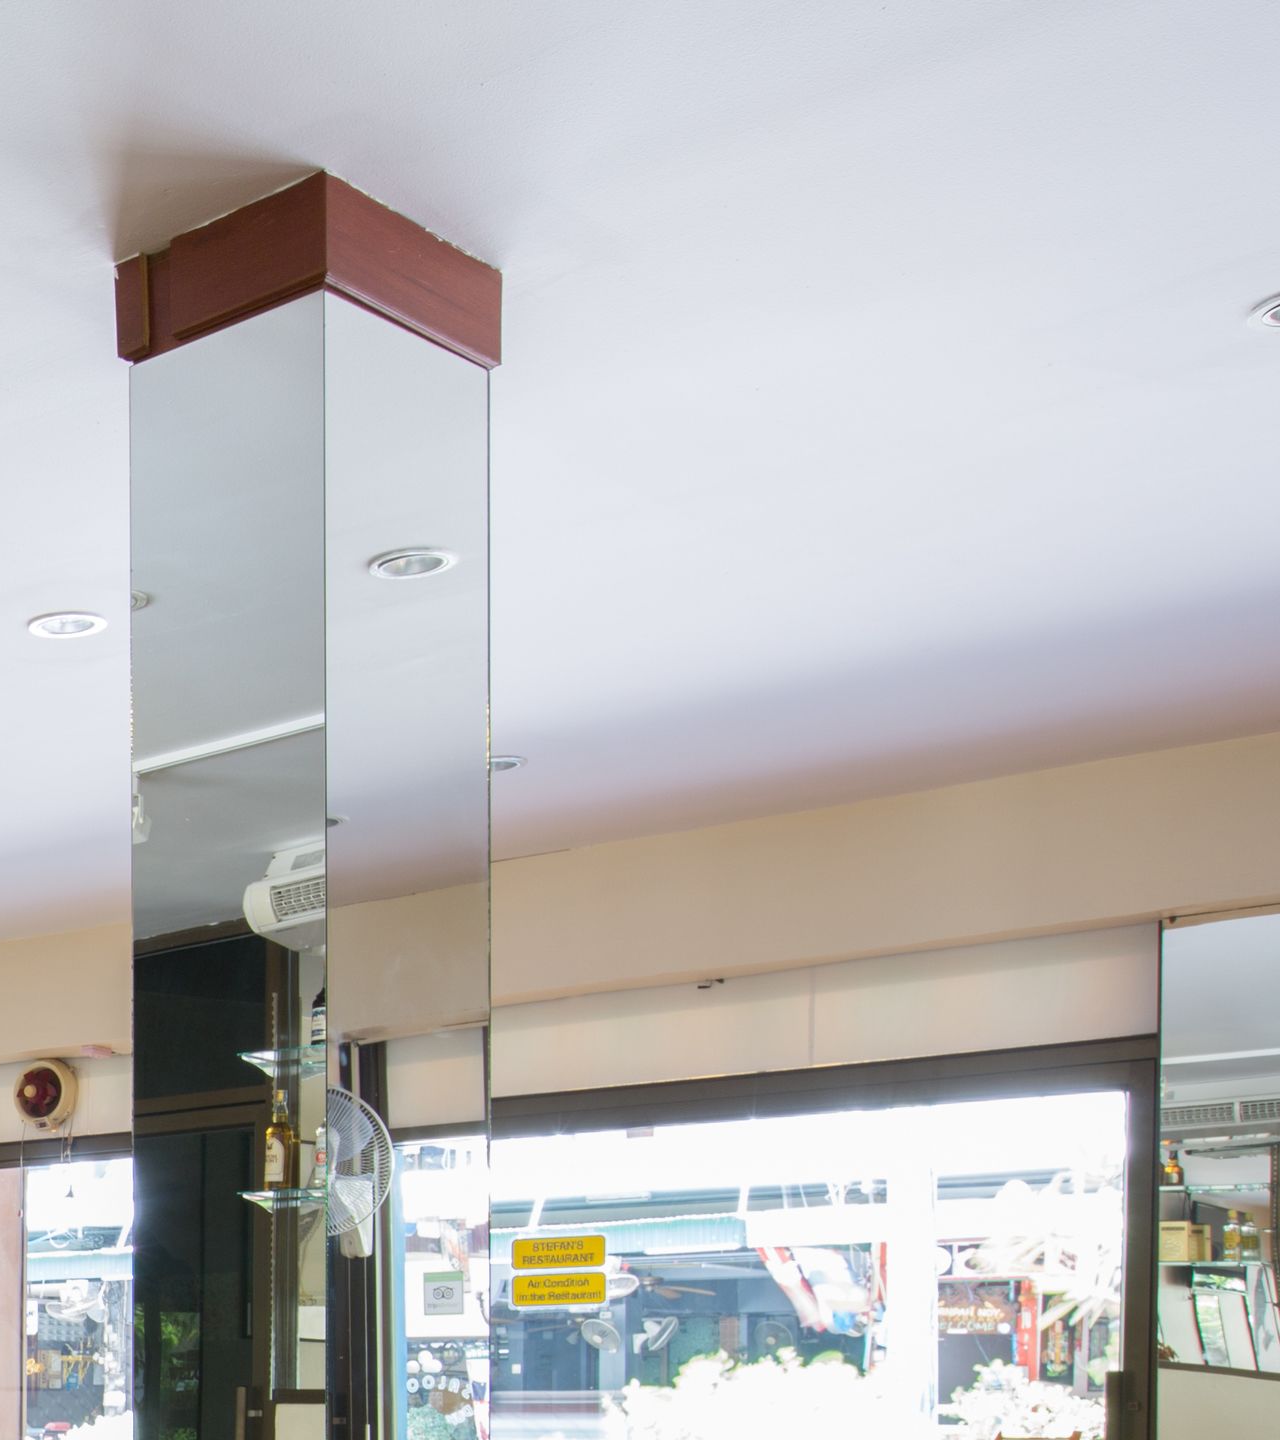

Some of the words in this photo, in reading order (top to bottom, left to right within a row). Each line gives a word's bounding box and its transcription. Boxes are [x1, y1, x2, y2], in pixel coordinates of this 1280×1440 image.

[532, 1240, 584, 1252] STEFAN'S
[522, 1253, 595, 1265] RESTAURANT
[528, 1279, 540, 1289] Air
[543, 1278, 590, 1288] Condition
[530, 1292, 545, 1301] the
[547, 1290, 602, 1301] Restaurant
